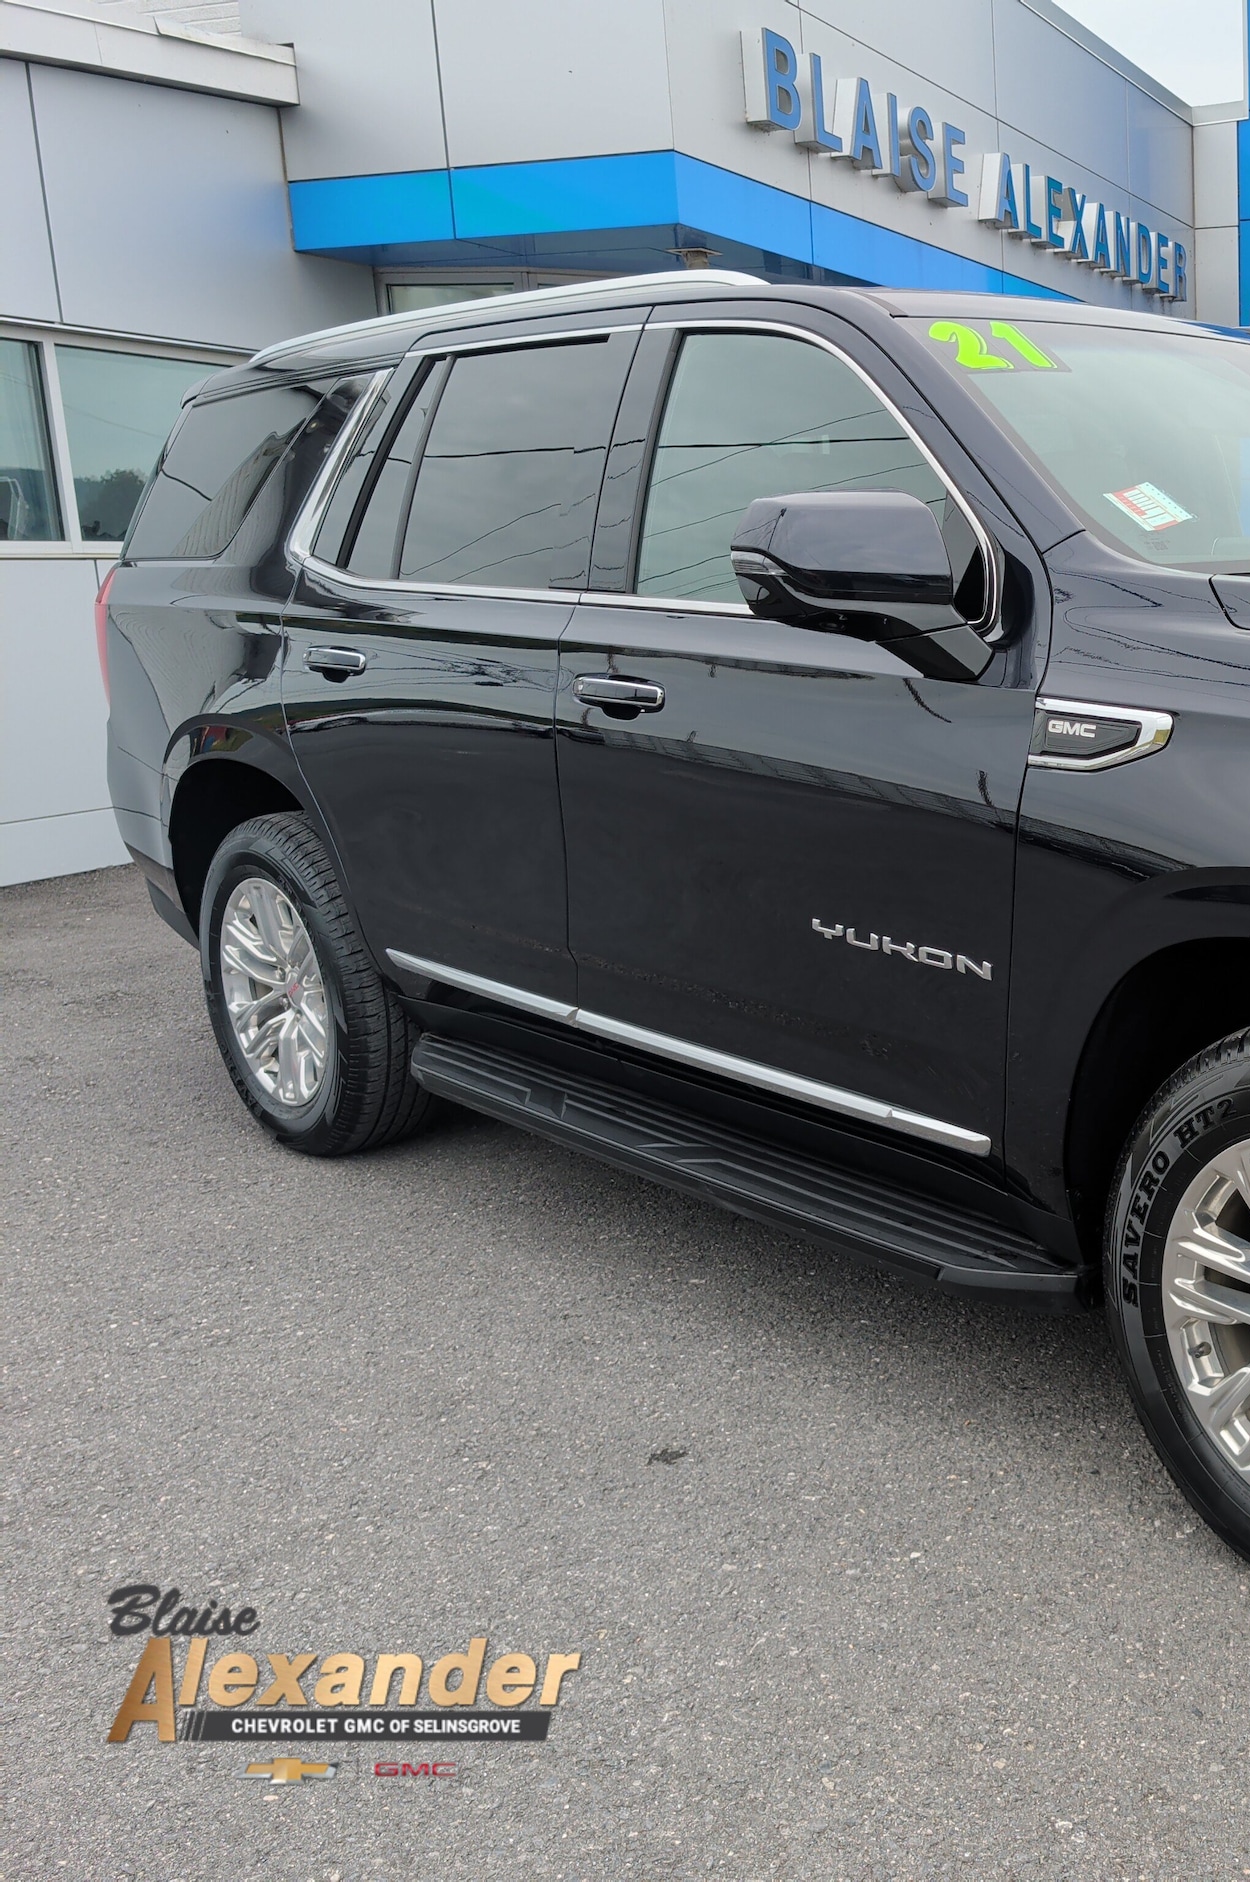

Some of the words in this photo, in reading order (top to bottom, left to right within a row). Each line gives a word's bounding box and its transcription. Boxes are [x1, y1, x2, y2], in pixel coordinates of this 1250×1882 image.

[762, 27, 968, 208] BLAISE
[1000, 152, 1188, 302] ALEXANDER
[928, 321, 1057, 369] 21
[1047, 718, 1097, 739] GMC
[811, 917, 994, 982] YUKON
[1122, 1150, 1170, 1307] SAVERO
